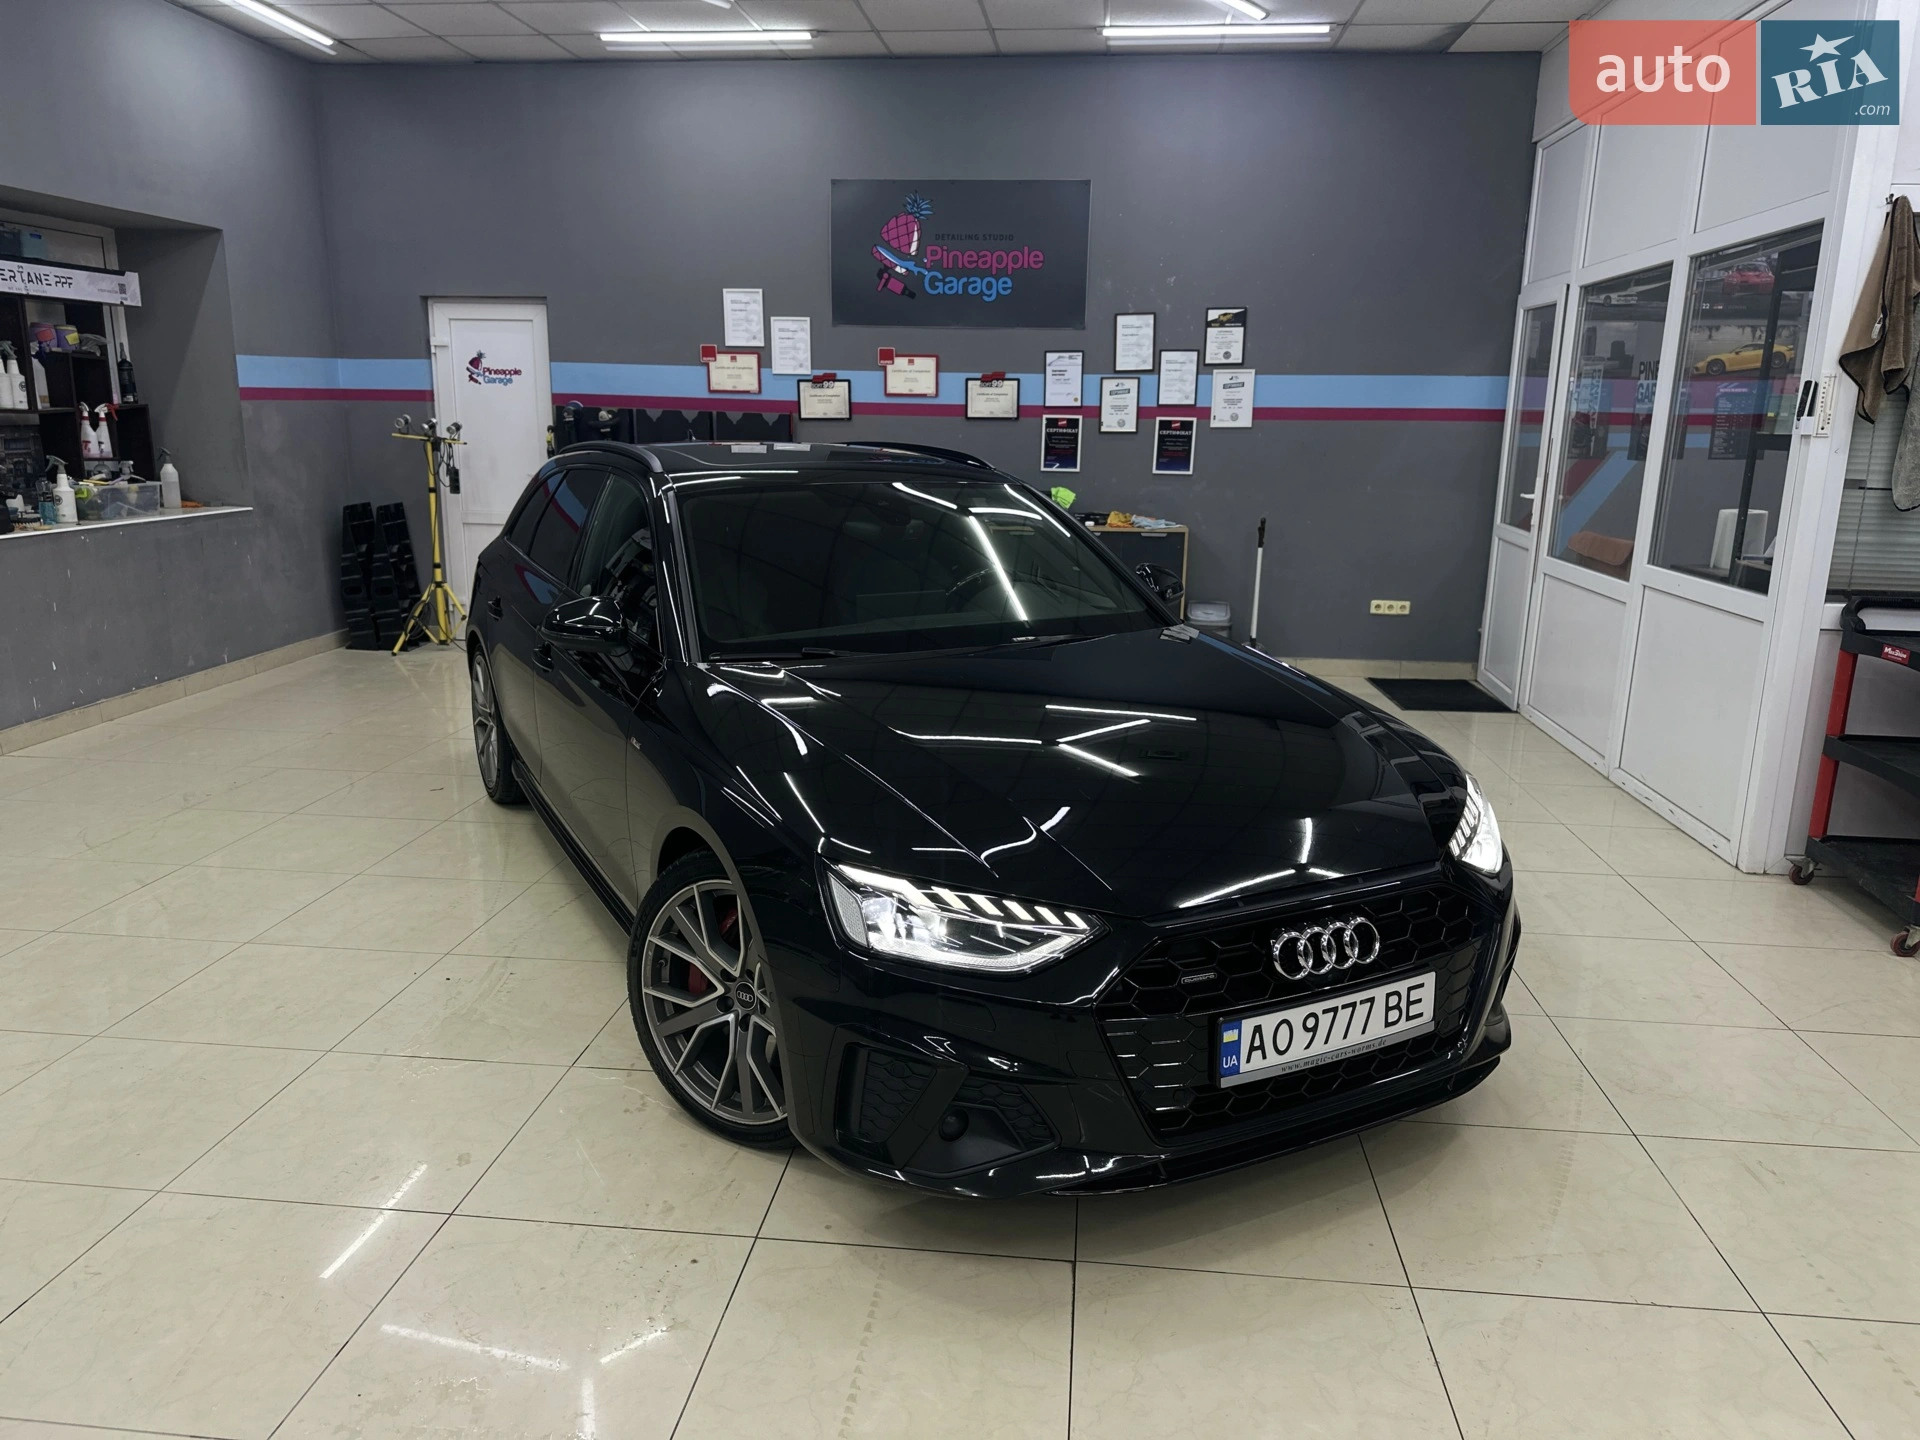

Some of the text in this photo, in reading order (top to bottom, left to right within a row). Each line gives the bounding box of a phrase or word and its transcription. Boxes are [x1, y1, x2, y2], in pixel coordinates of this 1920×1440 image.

[935, 233, 1014, 242] DETAILING STUDIO
[925, 245, 1044, 276] Pineapple
[924, 271, 1013, 302] Garage
[482, 367, 522, 377] Pineapple
[483, 376, 513, 386] Garage
[1245, 982, 1425, 1064] AO 9777 BE
[1222, 1056, 1238, 1069] UA
[1280, 1038, 1388, 1073] www.magic-cars-worms.de
